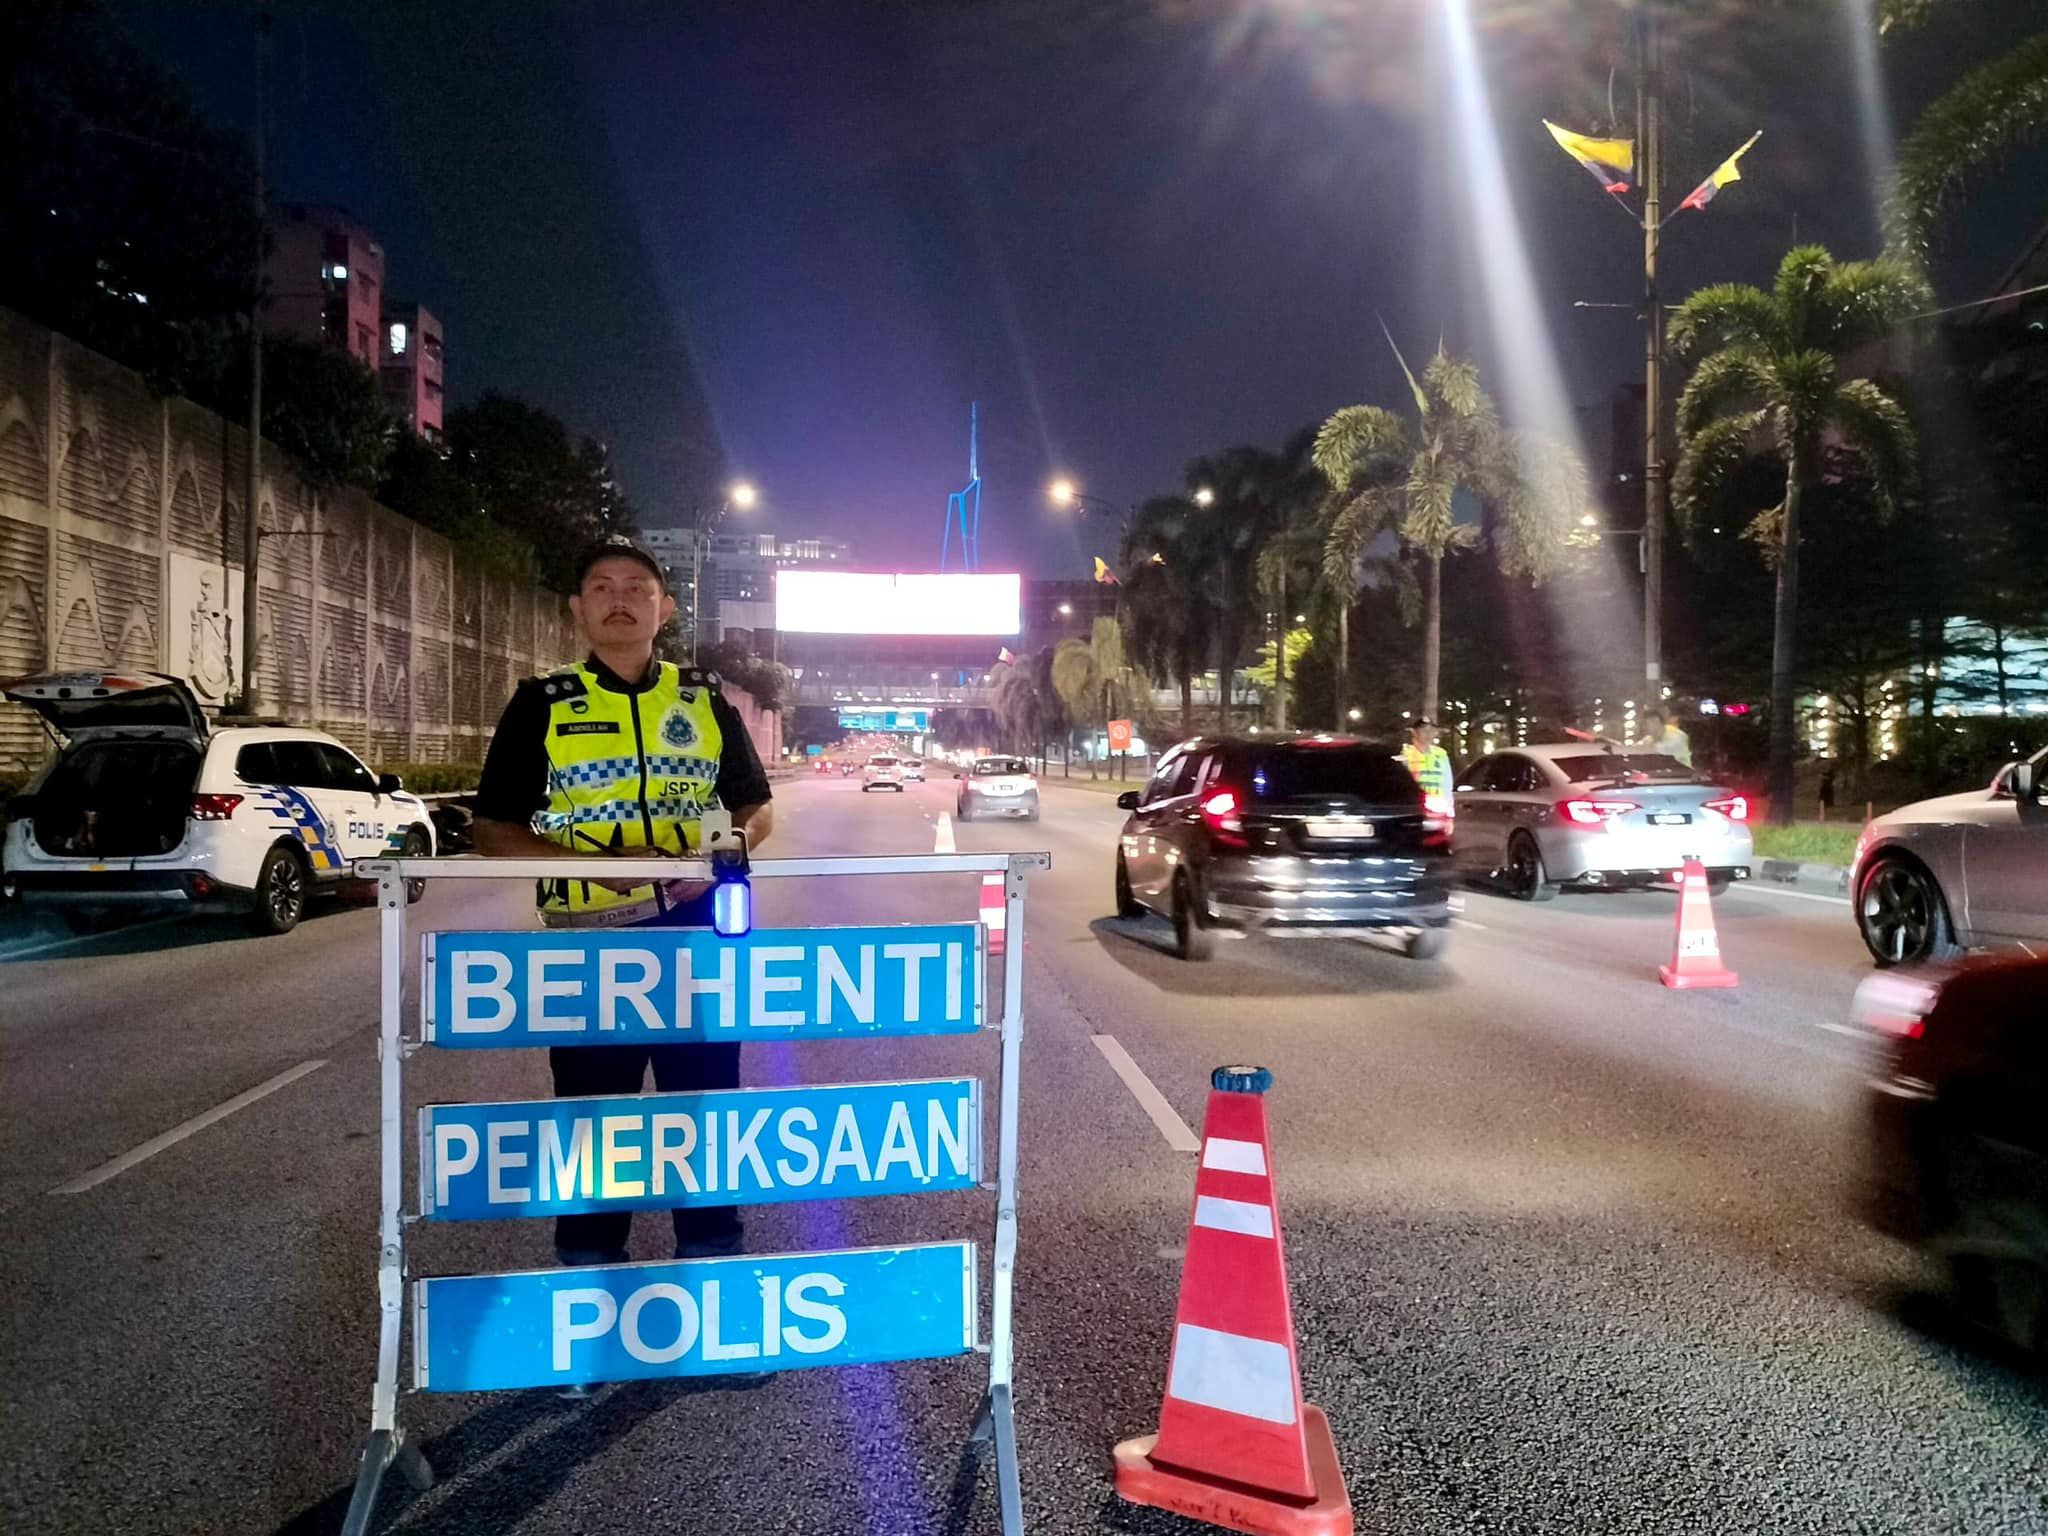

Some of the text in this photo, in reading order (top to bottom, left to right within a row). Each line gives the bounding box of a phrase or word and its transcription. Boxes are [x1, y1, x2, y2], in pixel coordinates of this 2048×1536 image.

[348, 822, 384, 839] POLIS
[659, 781, 699, 797] JSPT
[450, 942, 963, 1034] BERHENTI
[435, 1096, 969, 1207] PEMERIKSAAN
[551, 1271, 848, 1372] POLIS
